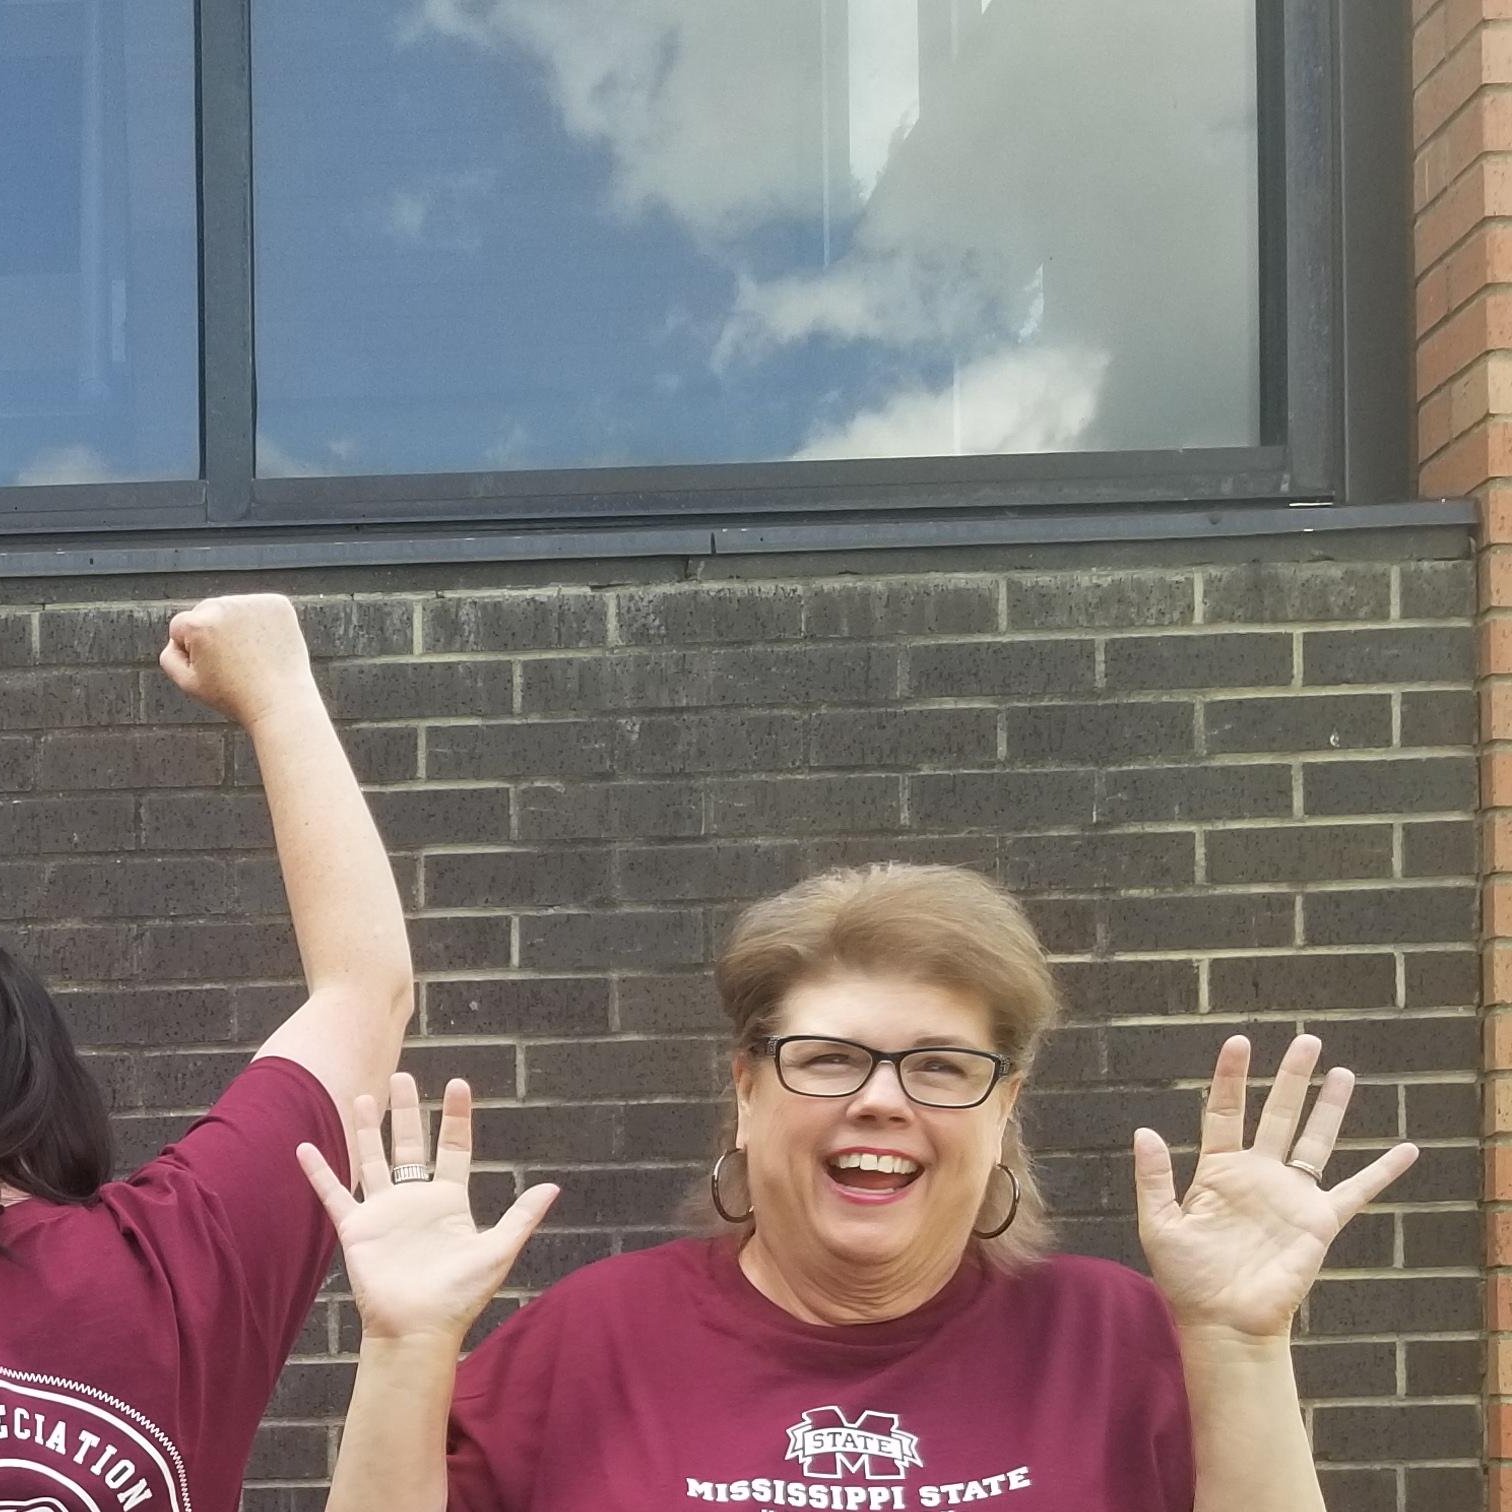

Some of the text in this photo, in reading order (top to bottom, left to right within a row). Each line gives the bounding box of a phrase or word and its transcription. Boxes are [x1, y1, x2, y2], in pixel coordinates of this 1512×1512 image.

[812, 1431, 893, 1455] STATE
[685, 1465, 1032, 1511] MISSISSIPPI STATE
